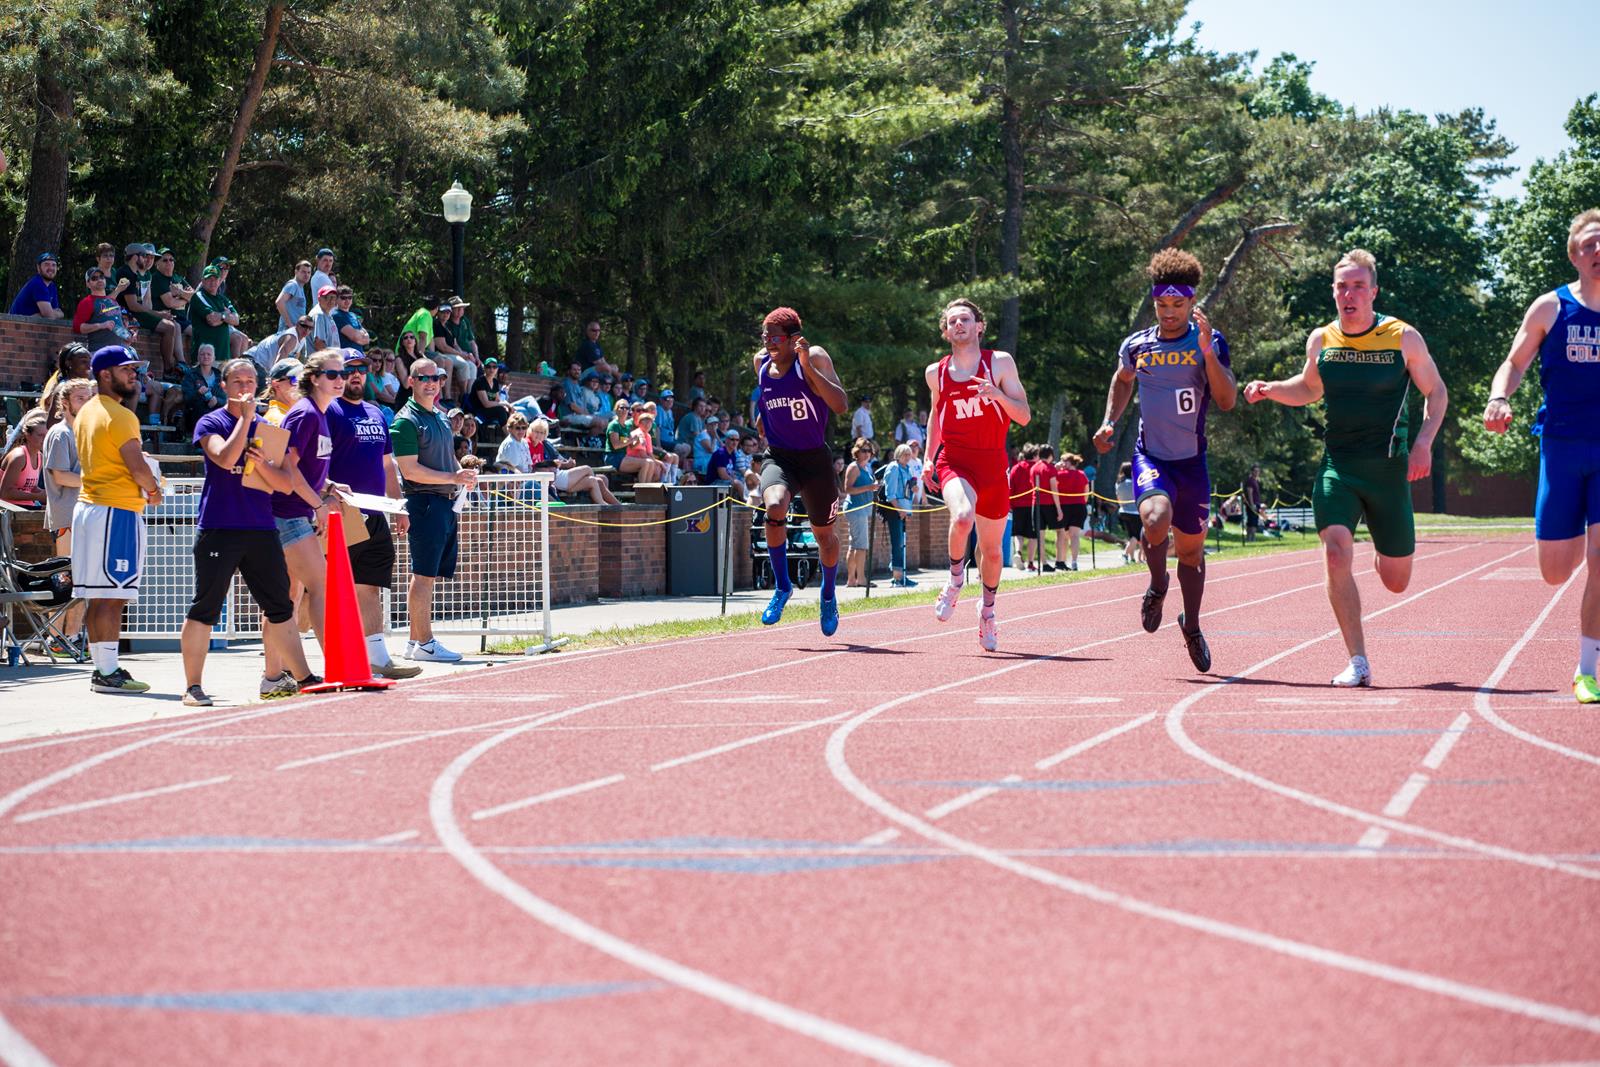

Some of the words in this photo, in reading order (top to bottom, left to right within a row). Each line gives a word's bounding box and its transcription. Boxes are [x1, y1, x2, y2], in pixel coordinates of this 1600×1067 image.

[1136, 350, 1198, 368] KNOX
[766, 397, 796, 410] CORNEL
[1179, 390, 1193, 412] 6
[793, 401, 806, 419] 8
[356, 425, 386, 435] KNOX
[230, 465, 244, 474] CO
